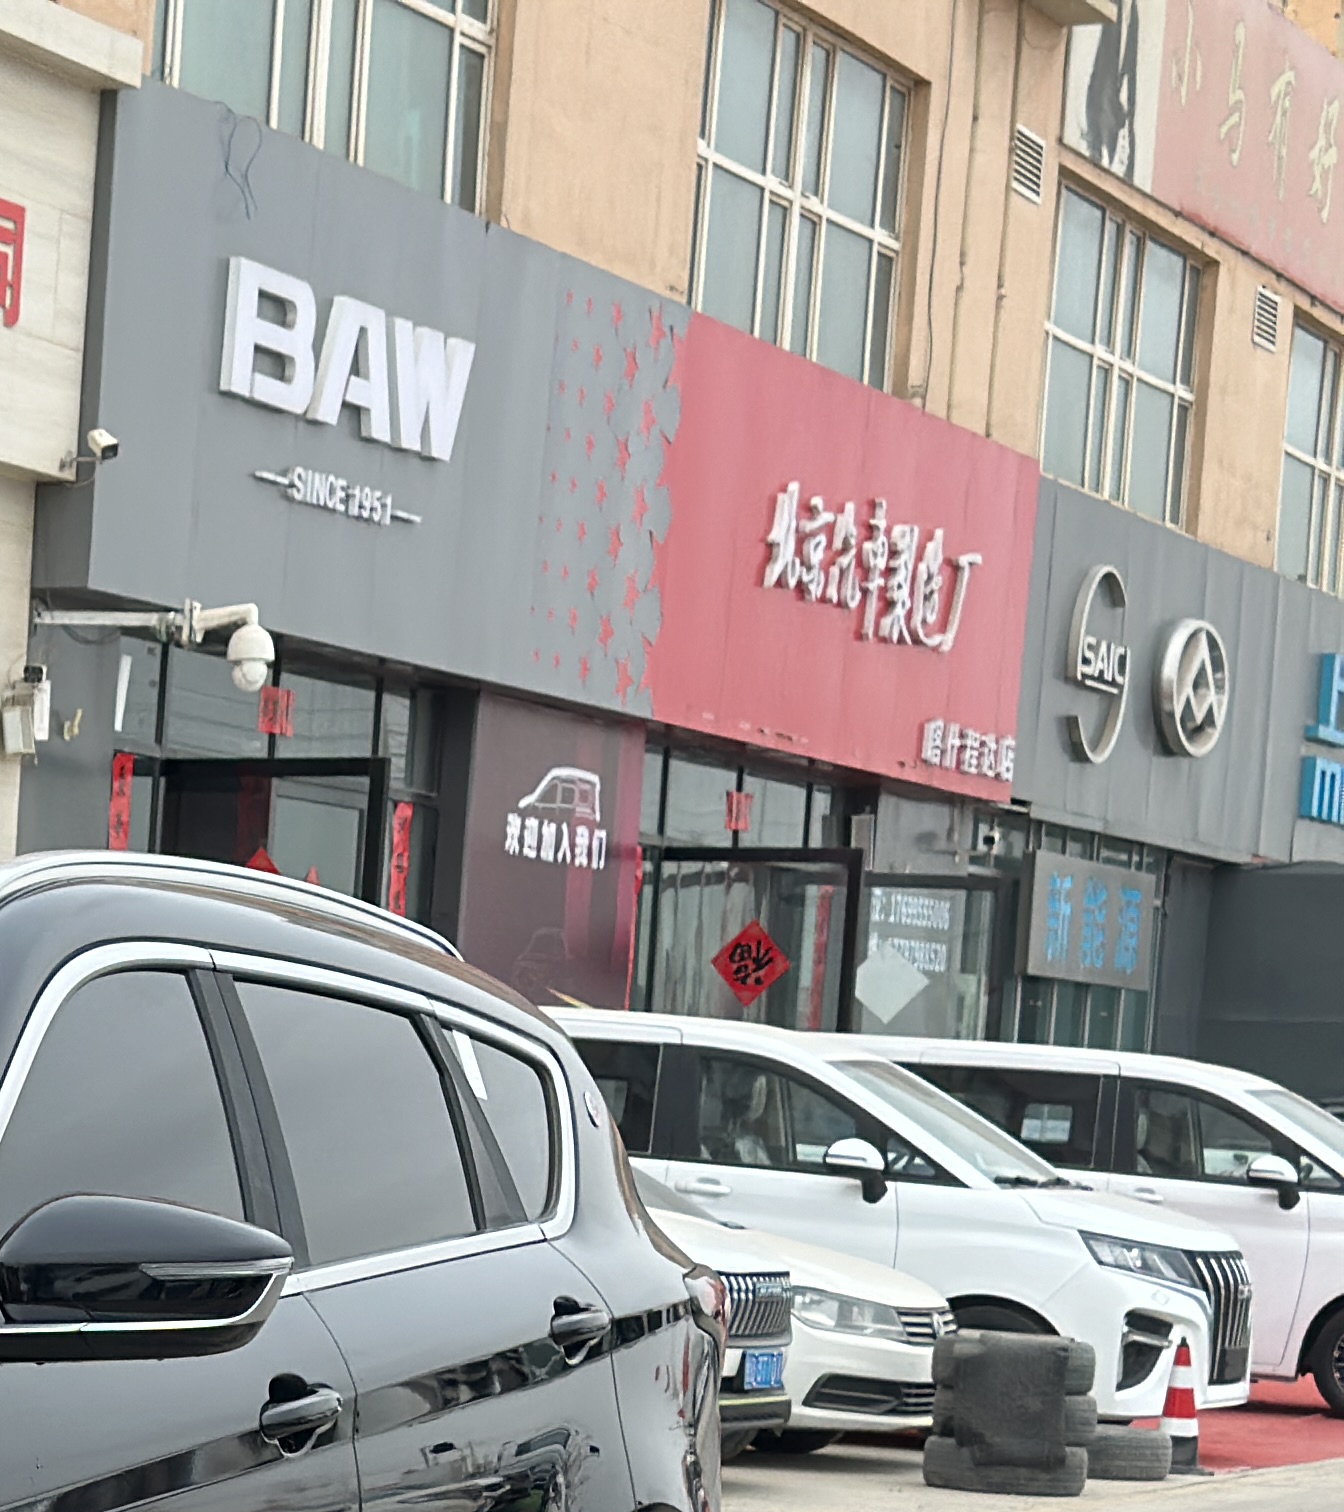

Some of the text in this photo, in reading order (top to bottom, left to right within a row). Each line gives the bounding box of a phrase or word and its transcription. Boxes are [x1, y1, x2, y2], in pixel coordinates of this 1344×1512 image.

[218, 255, 476, 463] BAW
[288, 465, 393, 526] SINCE 1951
[1081, 635, 1128, 686] SAIC
[504, 812, 608, 871] 欢迎加入我们
